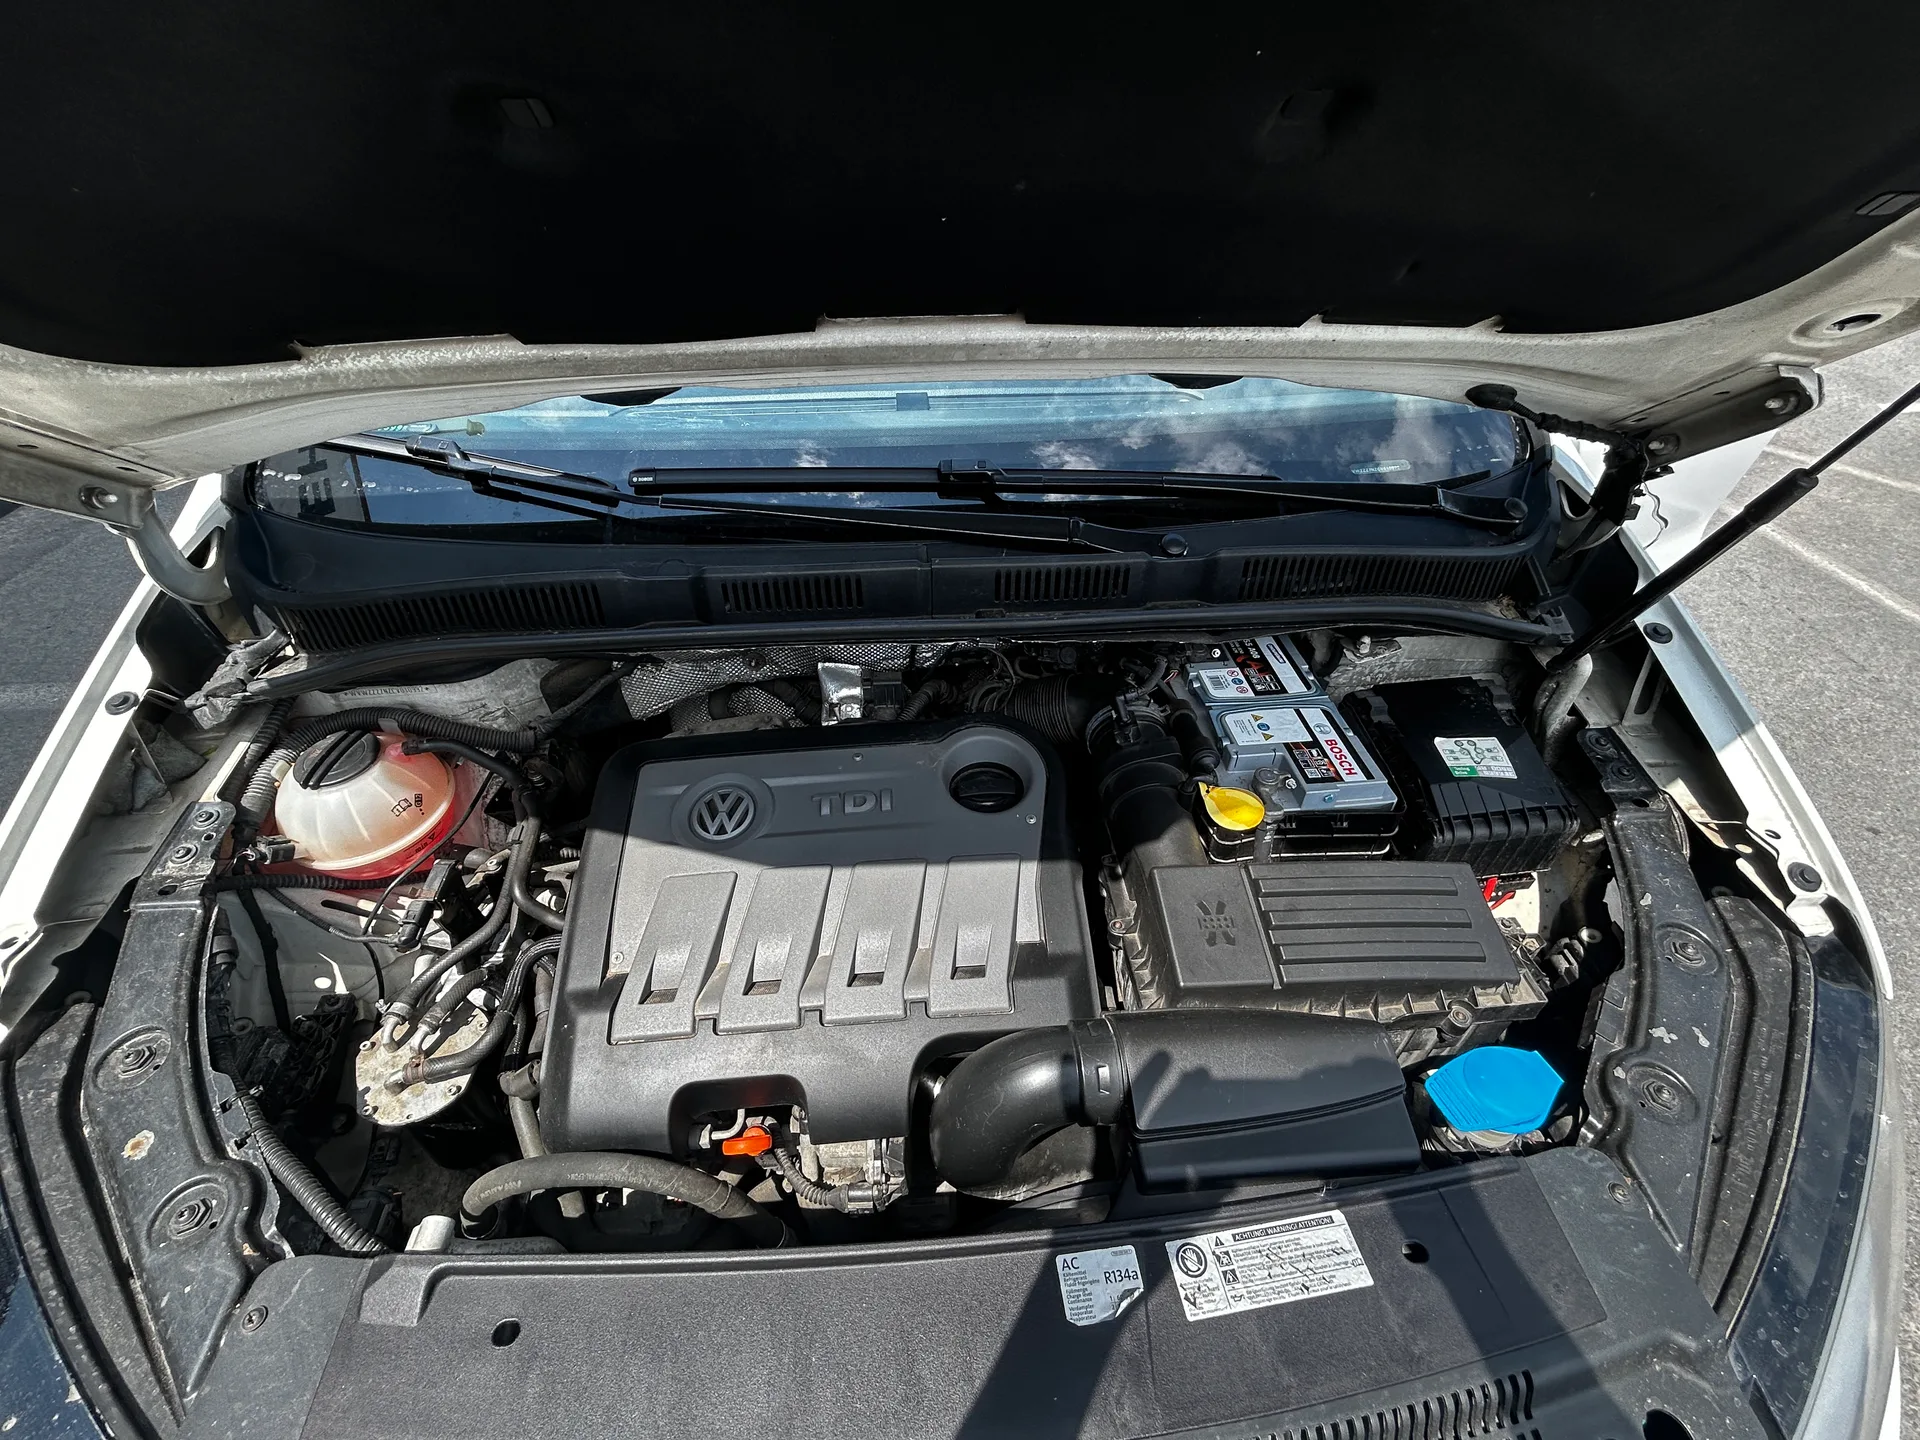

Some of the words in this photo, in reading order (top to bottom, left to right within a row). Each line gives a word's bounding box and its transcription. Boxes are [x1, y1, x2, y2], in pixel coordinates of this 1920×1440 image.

[1324, 739, 1358, 777] BOSCH
[811, 788, 894, 817] TDI
[1234, 1227, 1266, 1241] ACHTUNG!
[1266, 1222, 1298, 1235] WARNING!
[1298, 1216, 1332, 1230] ATTENTION!
[1062, 1256, 1080, 1271] AC
[1103, 1268, 1139, 1284] R134a
